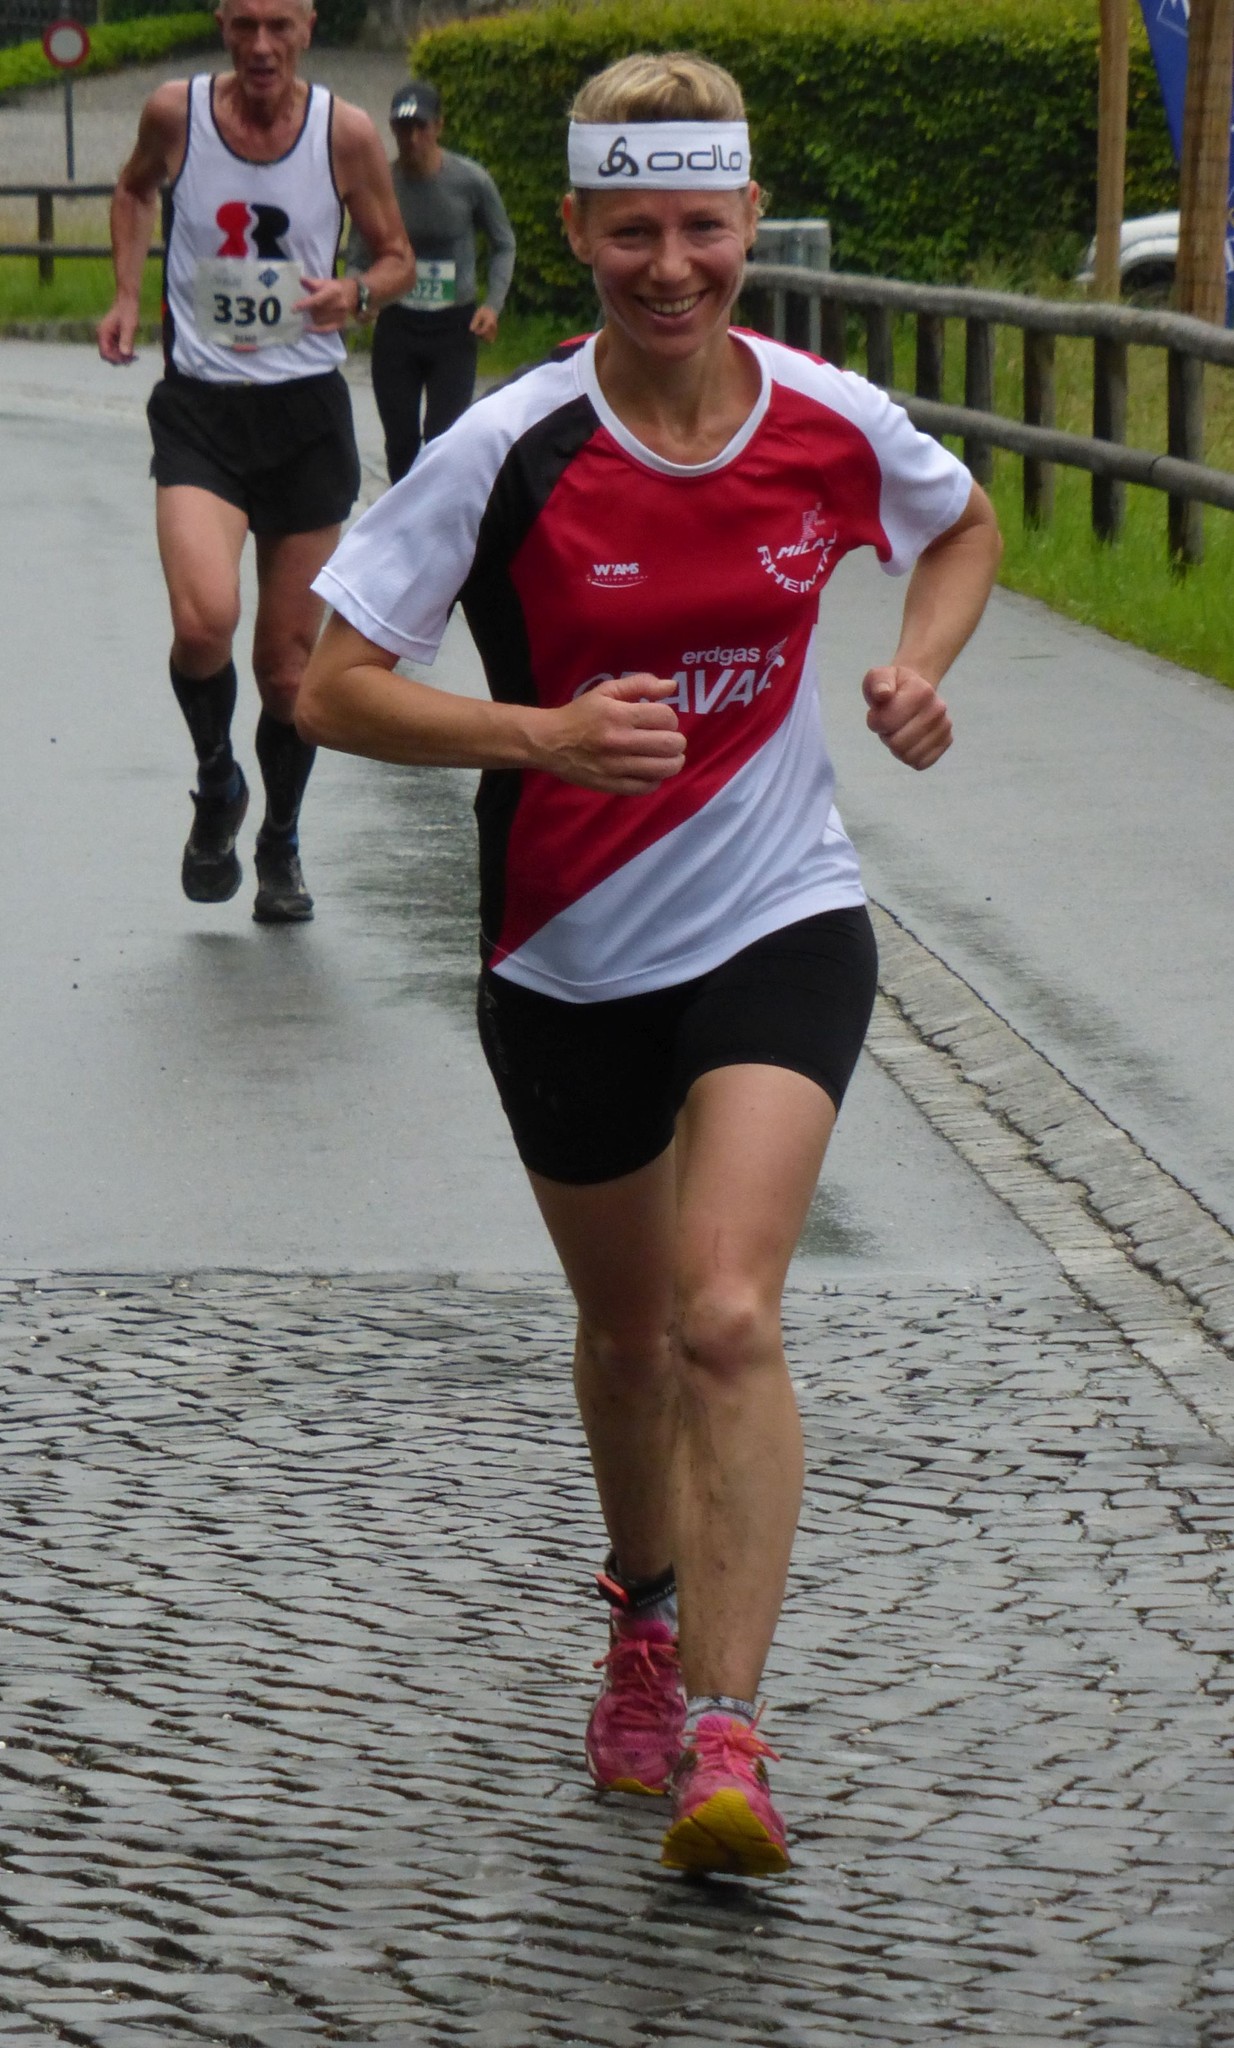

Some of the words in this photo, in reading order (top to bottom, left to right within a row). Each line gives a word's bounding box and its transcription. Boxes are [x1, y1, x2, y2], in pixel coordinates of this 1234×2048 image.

[647, 144, 742, 171] odlo
[213, 293, 281, 327] 330
[682, 646, 761, 666] erdgas
